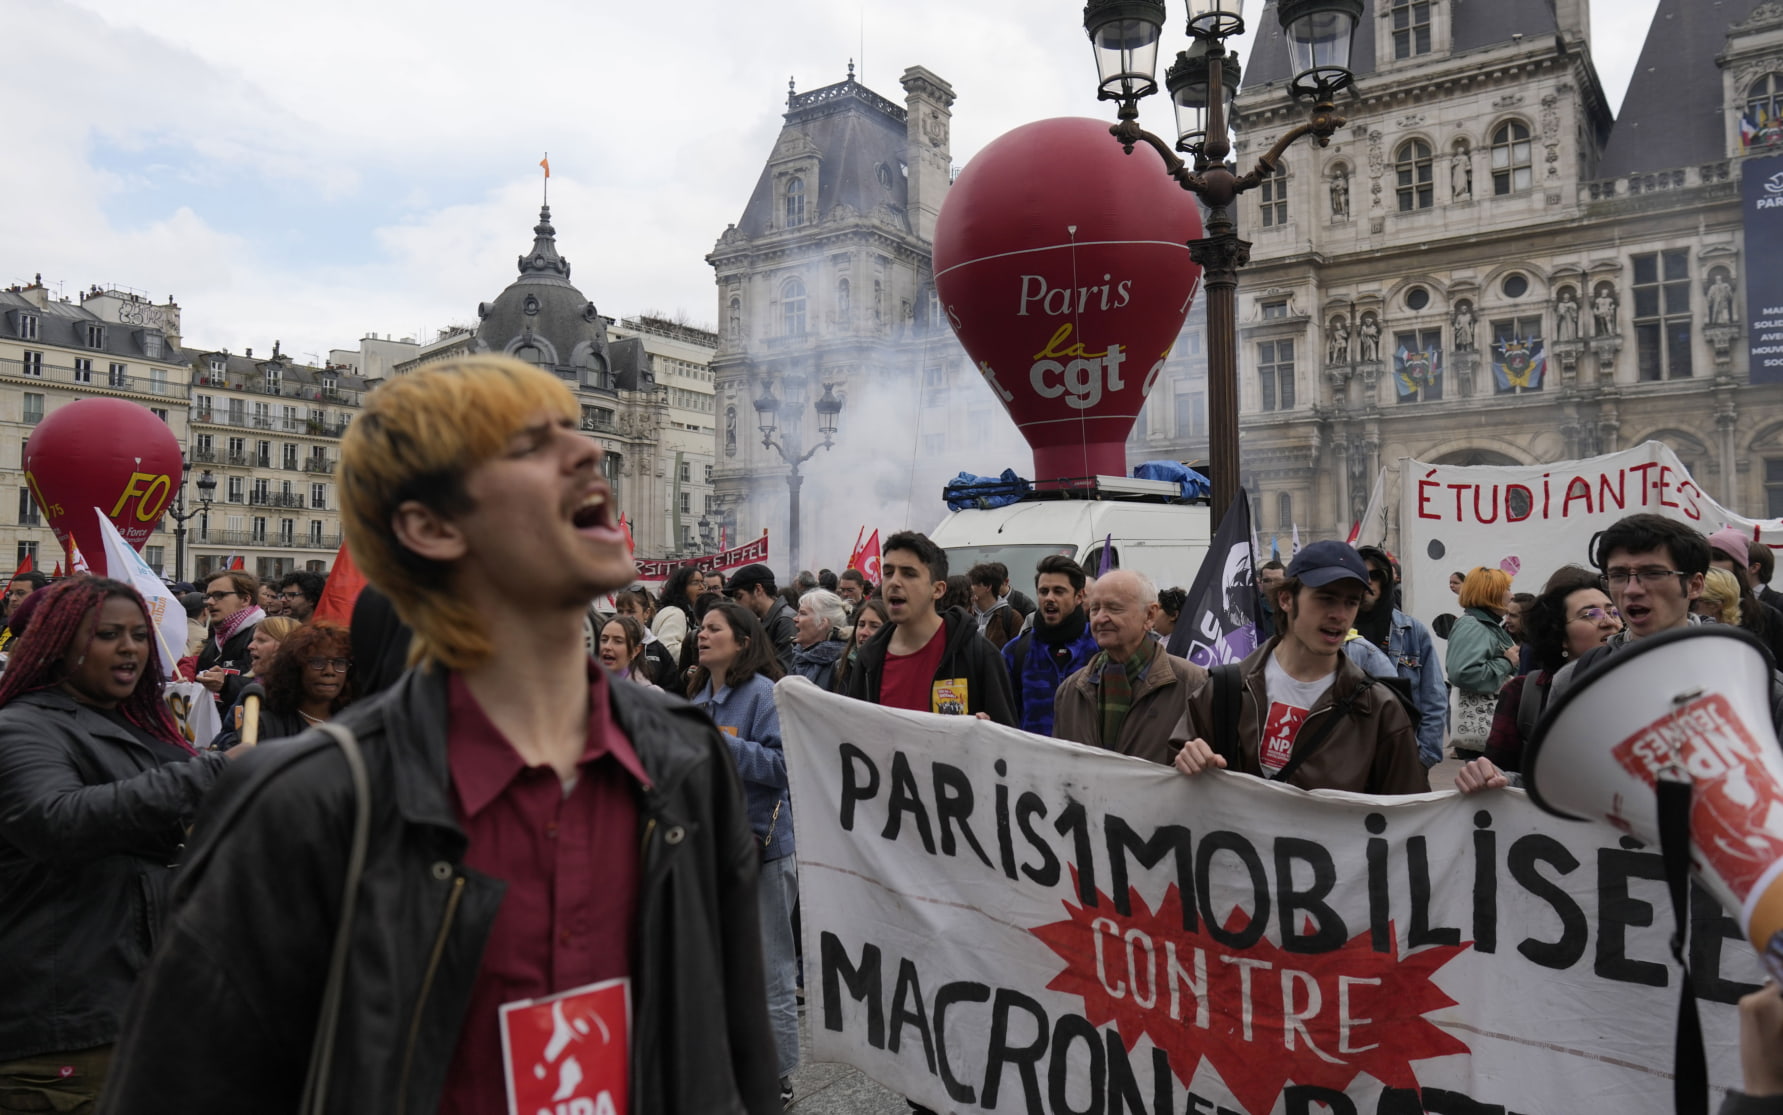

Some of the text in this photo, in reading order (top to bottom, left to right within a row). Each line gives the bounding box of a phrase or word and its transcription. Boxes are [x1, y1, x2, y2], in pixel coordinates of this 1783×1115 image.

[1017, 274, 1132, 316] Paris
[1033, 323, 1126, 359] la
[1029, 344, 1126, 409] cgt
[109, 471, 170, 522] FO
[1268, 736, 1292, 754] NP
[1092, 916, 1383, 1064] CONTRE
[820, 930, 1173, 1115] MACRON
